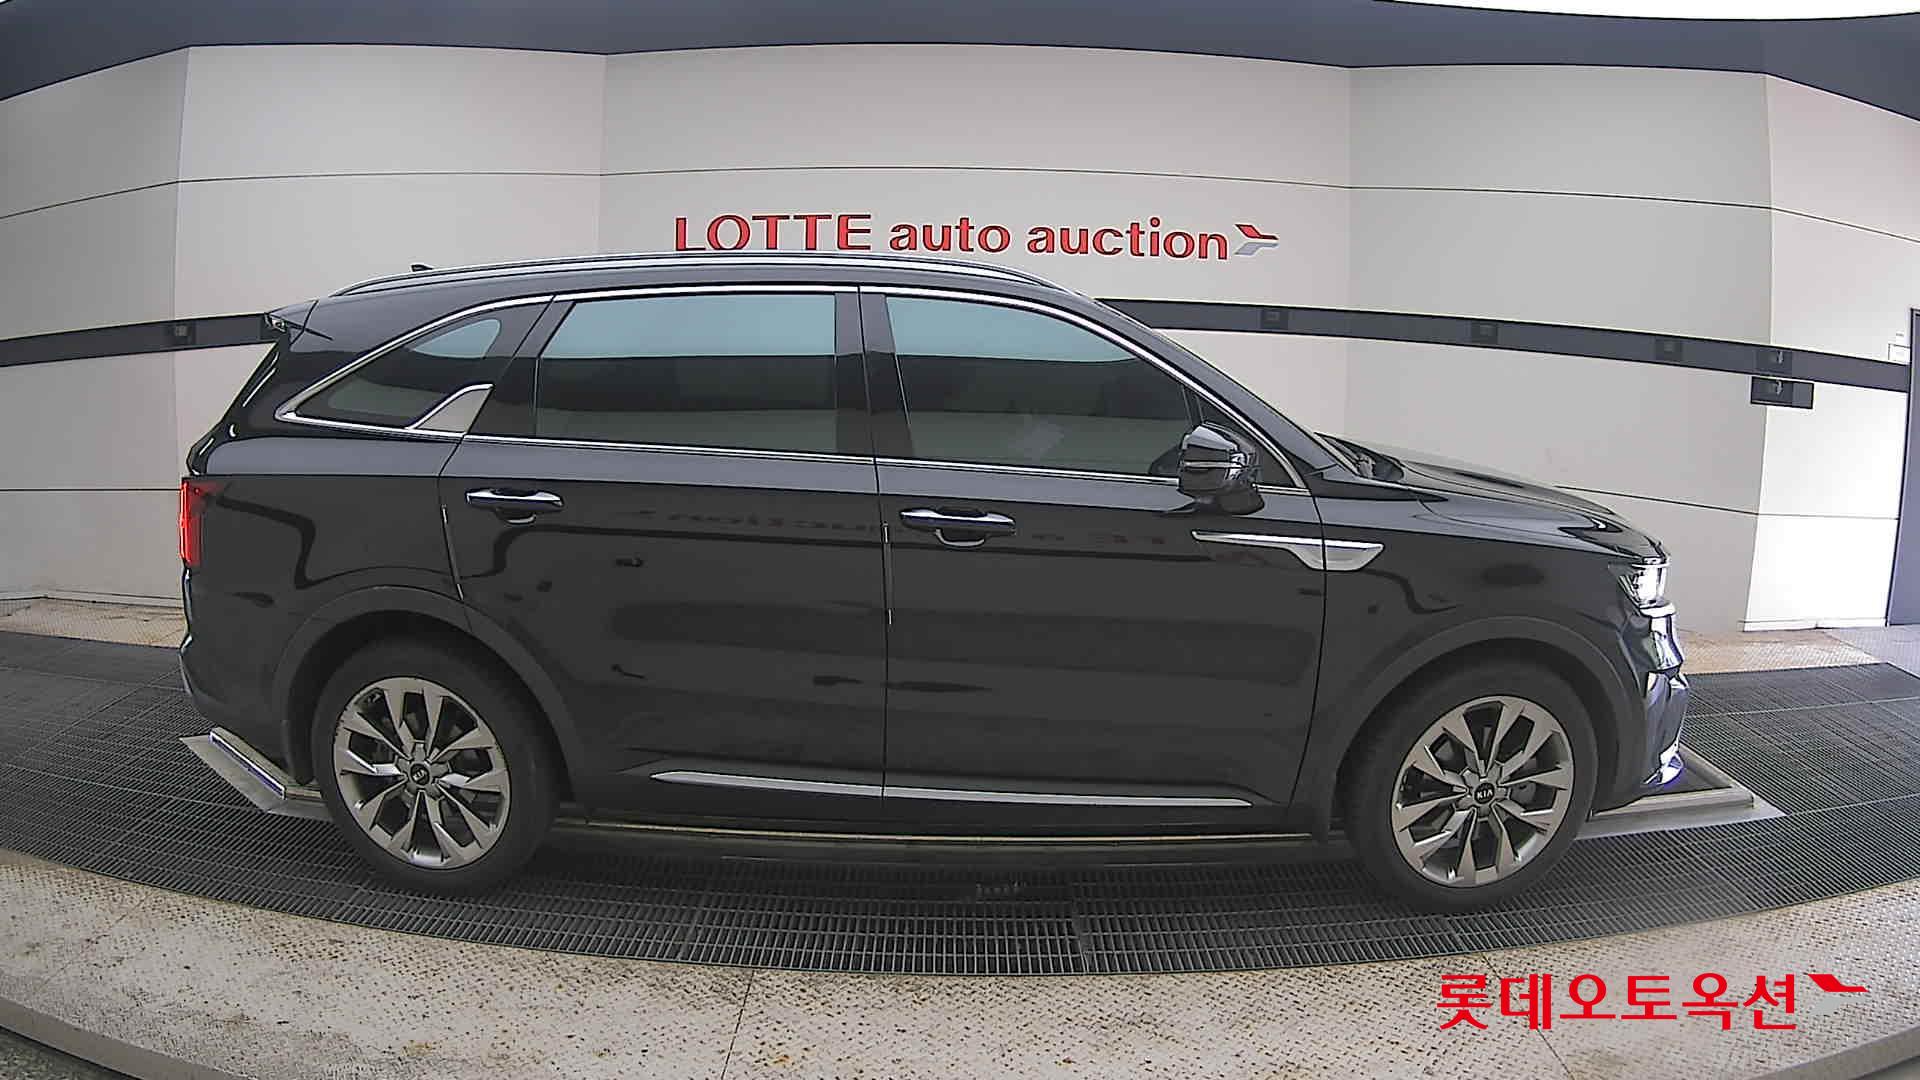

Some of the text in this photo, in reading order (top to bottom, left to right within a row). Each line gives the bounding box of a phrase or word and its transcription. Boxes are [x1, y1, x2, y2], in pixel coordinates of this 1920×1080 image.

[675, 213, 1229, 260] LOTTE auto auction
